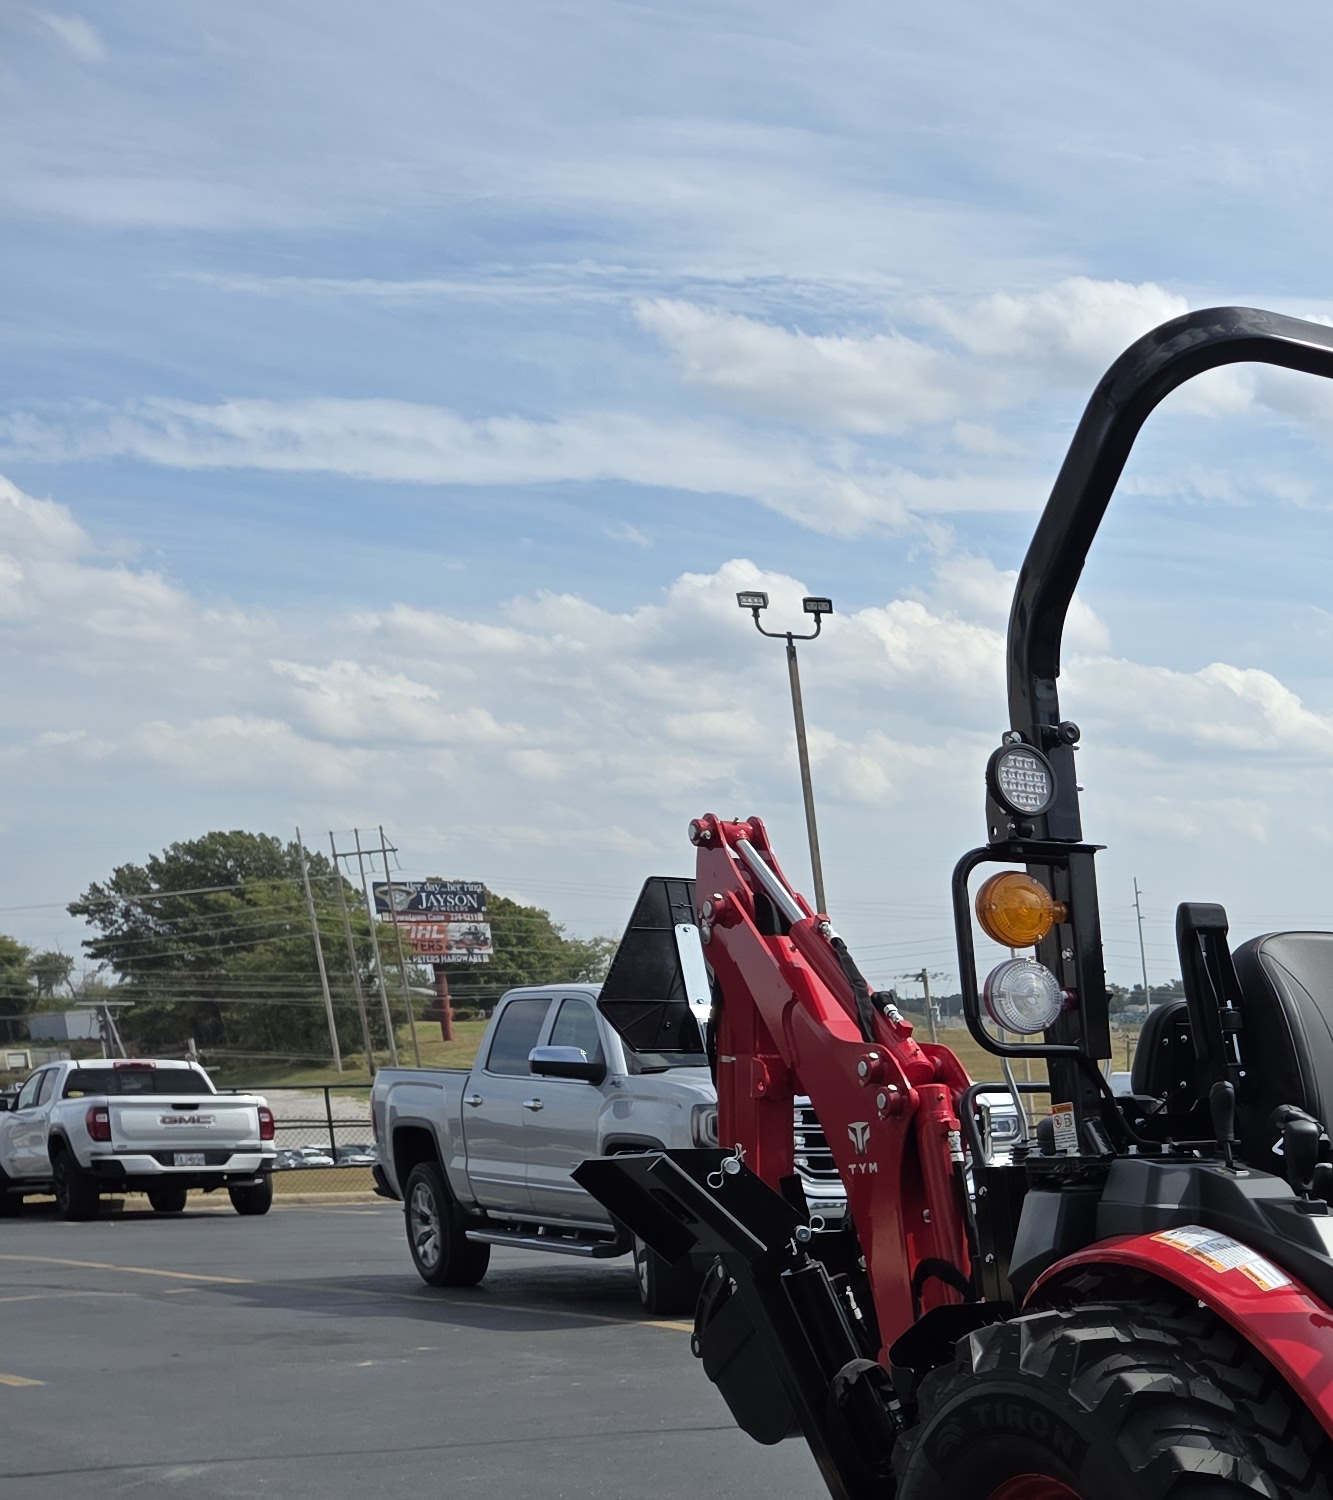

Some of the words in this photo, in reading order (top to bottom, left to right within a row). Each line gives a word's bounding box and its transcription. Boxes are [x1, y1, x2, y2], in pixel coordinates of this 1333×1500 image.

[418, 892, 478, 910] JAYSON
[440, 954, 481, 964] HARDWARE
[160, 1114, 212, 1125] GMC
[848, 1162, 878, 1175] TYM
[971, 1402, 1076, 1461] TIRON
